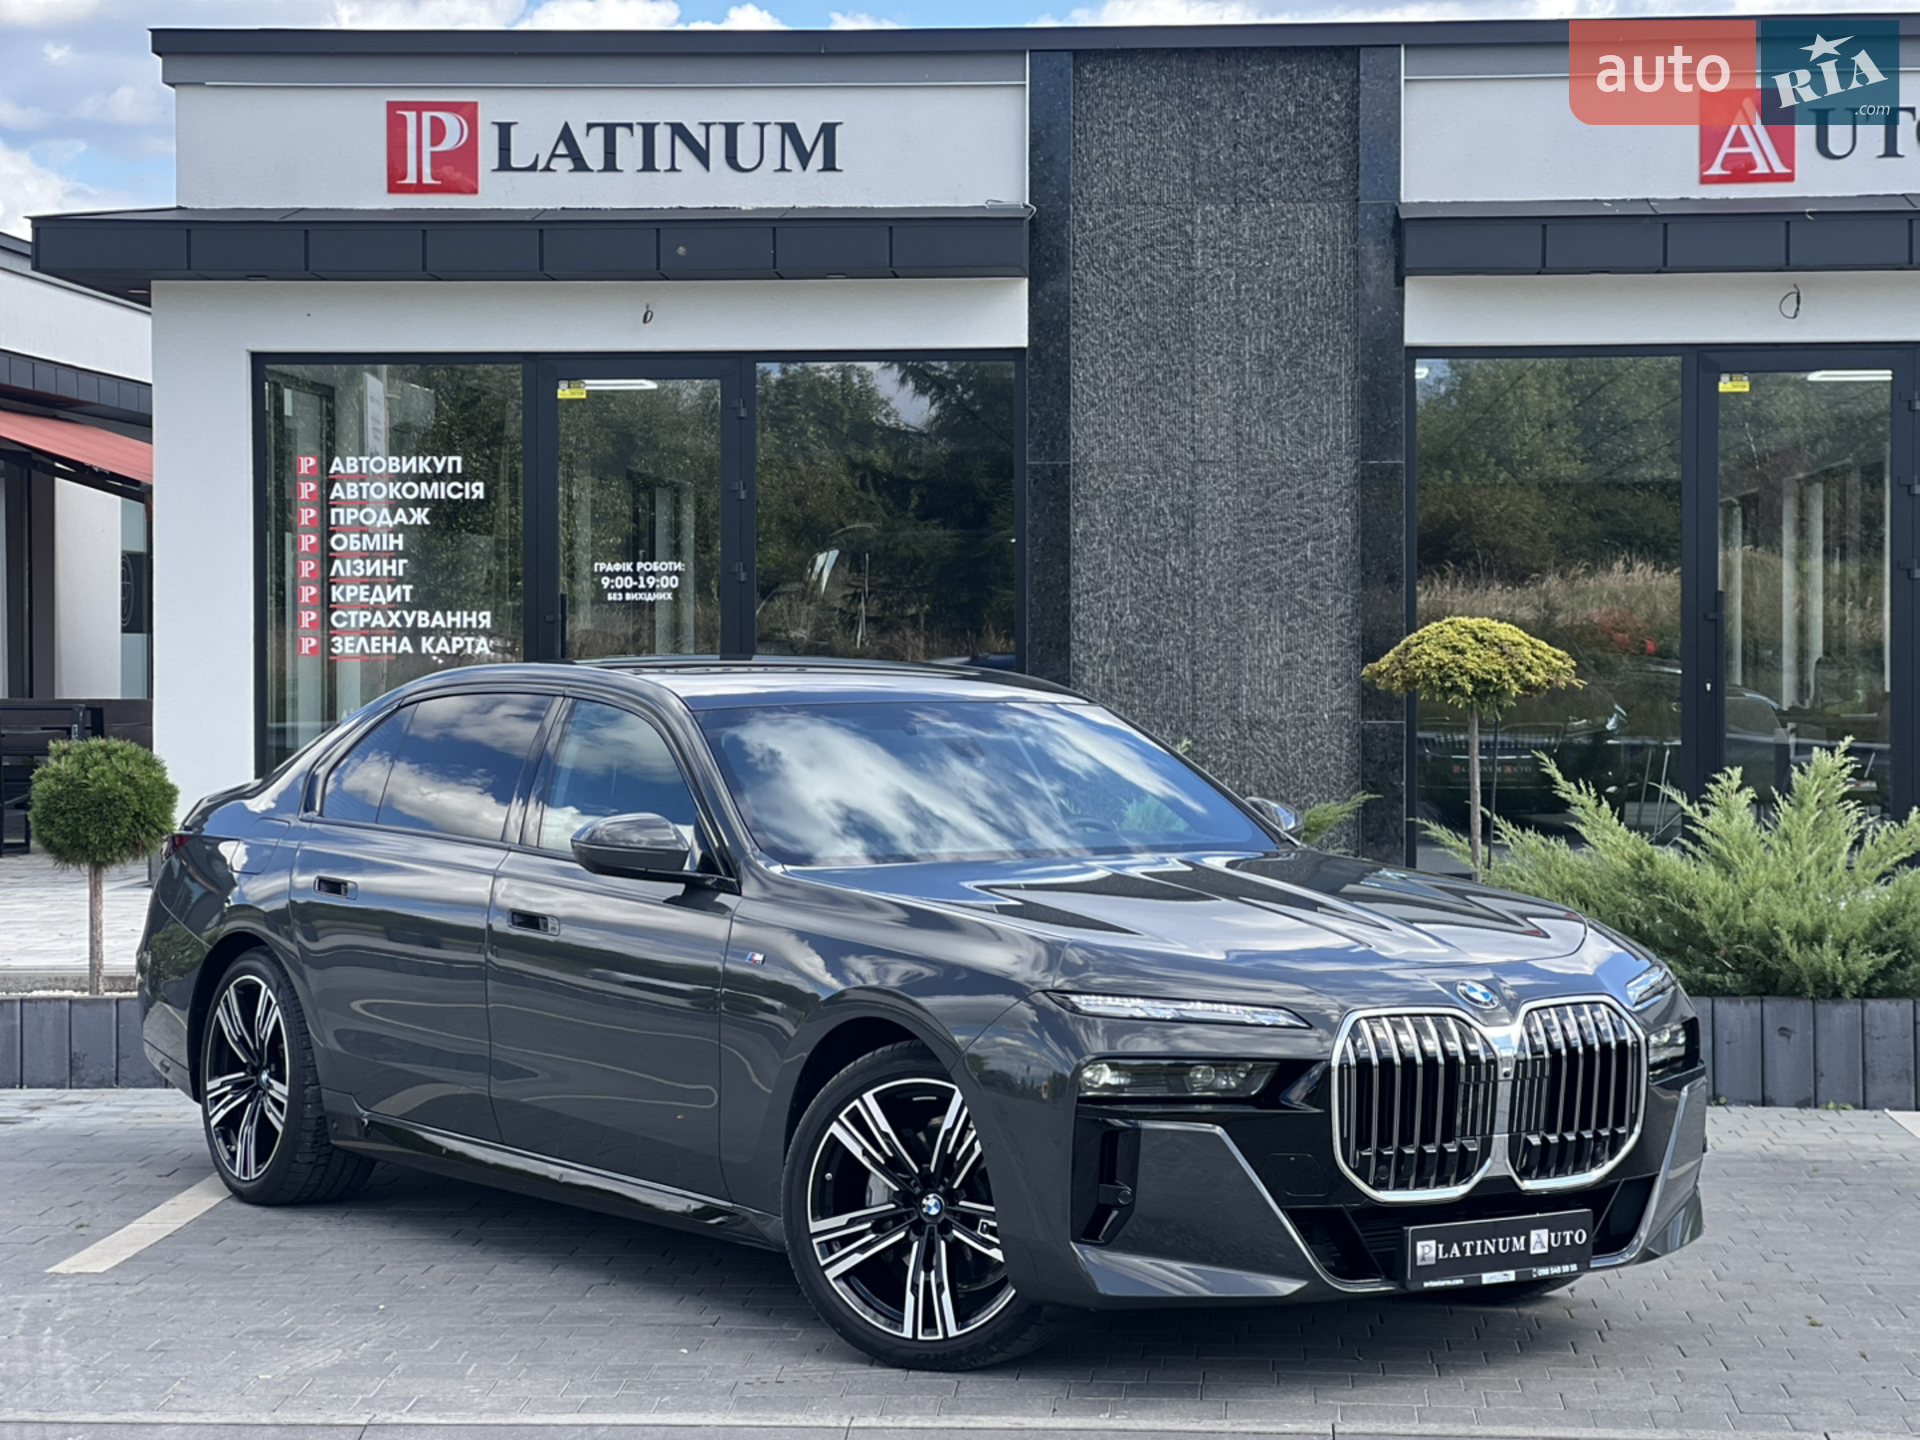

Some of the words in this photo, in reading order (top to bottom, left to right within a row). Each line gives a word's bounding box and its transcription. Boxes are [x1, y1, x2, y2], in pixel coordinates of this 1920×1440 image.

[1702, 97, 1920, 176] AUT
[328, 455, 463, 474] АВТОВИКУП
[328, 481, 485, 500] АВТОКОМІСІЯ
[330, 507, 431, 528] ПРОДАЖ
[330, 533, 404, 551] ОБМІН
[329, 559, 408, 577] ЛІЗИНГ
[594, 562, 634, 573] ГРАФІК
[636, 561, 685, 572] РОБОТИ:
[601, 575, 679, 589] 9:00-19:00
[330, 585, 414, 605] КРЕДИТ
[607, 592, 624, 602] БЕЗ
[625, 592, 673, 602] ВИХІДНИХ
[330, 610, 492, 629] СТРАХУВАННЯ
[330, 636, 414, 654] ЗЕЛЕНА
[421, 636, 491, 655] КАРТА
[1418, 1235, 1527, 1264] PLATINUM
[1532, 1228, 1588, 1252] AUTO
